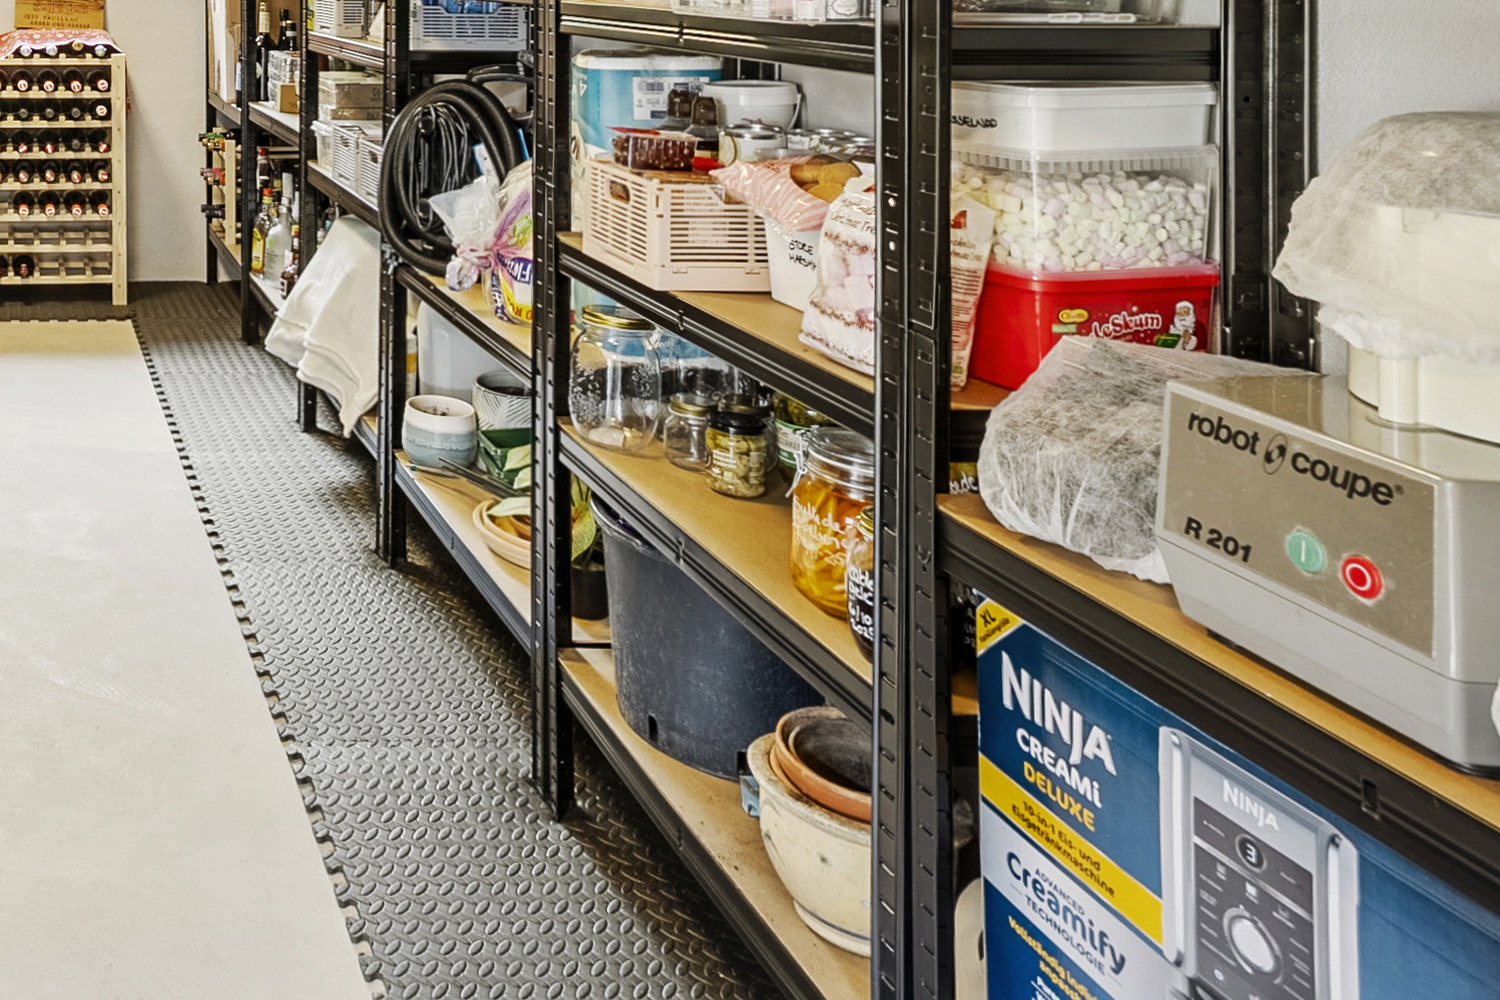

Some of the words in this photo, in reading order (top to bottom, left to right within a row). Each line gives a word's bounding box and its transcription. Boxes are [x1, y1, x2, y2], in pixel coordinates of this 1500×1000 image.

[1187, 412, 1261, 456] robot
[1183, 516, 1203, 541] R
[1206, 528, 1252, 563] 201
[979, 607, 996, 628] XL
[1002, 650, 1117, 776] NINJA
[1016, 727, 1102, 809] CREAMi
[1023, 760, 1096, 832] DELUXE
[1023, 801, 1056, 834] 10-in-1
[1058, 827, 1079, 851] Eis-
[1079, 848, 1101, 872] und
[1222, 778, 1280, 831] NINJA
[1012, 804, 1116, 898] Eisgetränkmaschine
[1246, 842, 1258, 864] 3
[1007, 851, 1127, 976] Creamify
[1035, 868, 1085, 916] ADVANCED
[1025, 894, 1106, 976] TECHNOLOGIE
